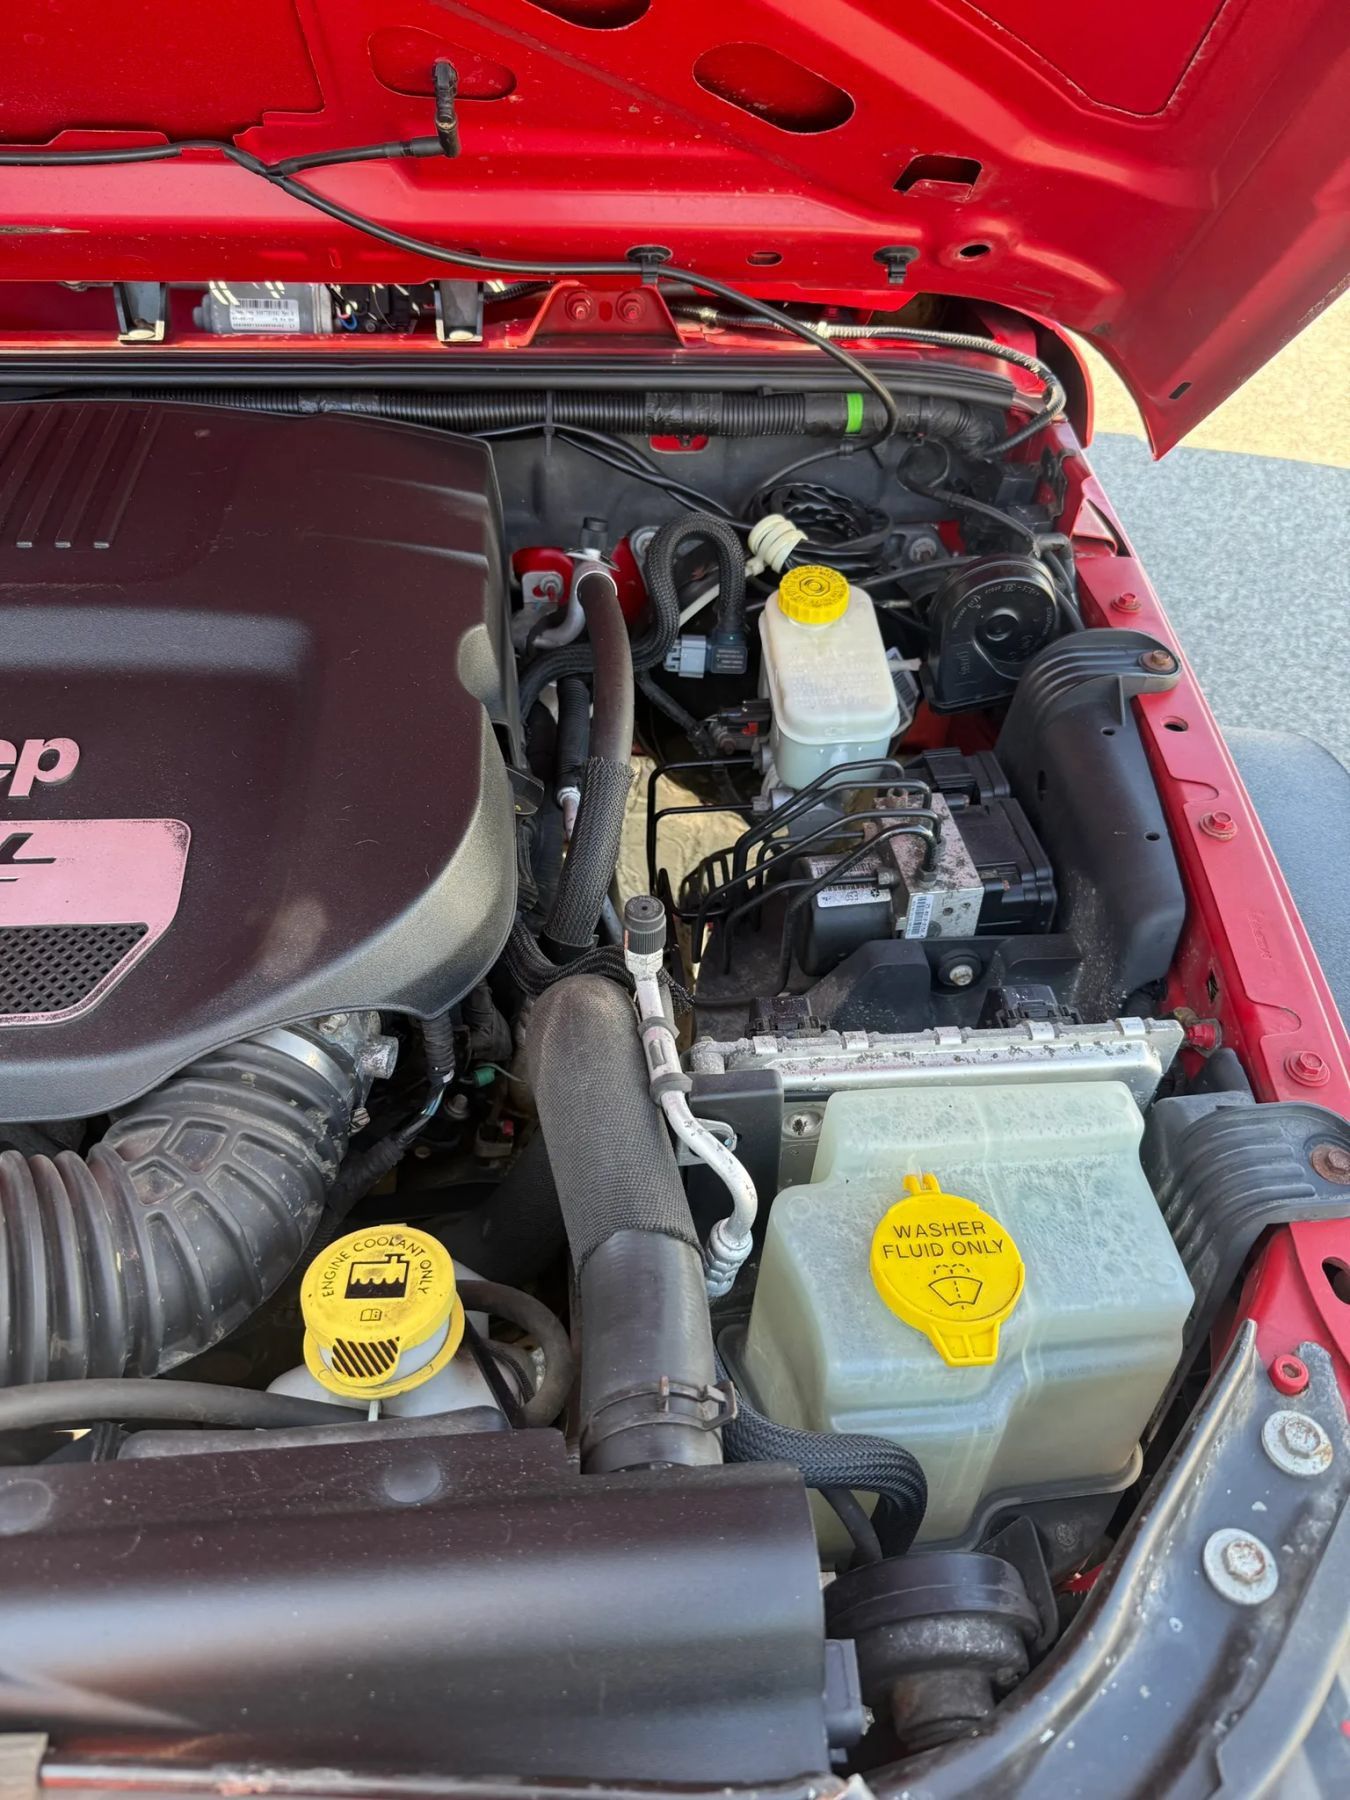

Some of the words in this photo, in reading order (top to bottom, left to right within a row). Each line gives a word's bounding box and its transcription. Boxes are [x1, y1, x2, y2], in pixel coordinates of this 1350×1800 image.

[893, 1221, 986, 1239] WASHER
[882, 1241, 944, 1259] FLUID
[951, 1239, 1003, 1256] ONLY
[322, 1250, 351, 1298] ENGINE
[353, 1236, 426, 1258] COOLANT
[417, 1259, 434, 1295] ONLY
